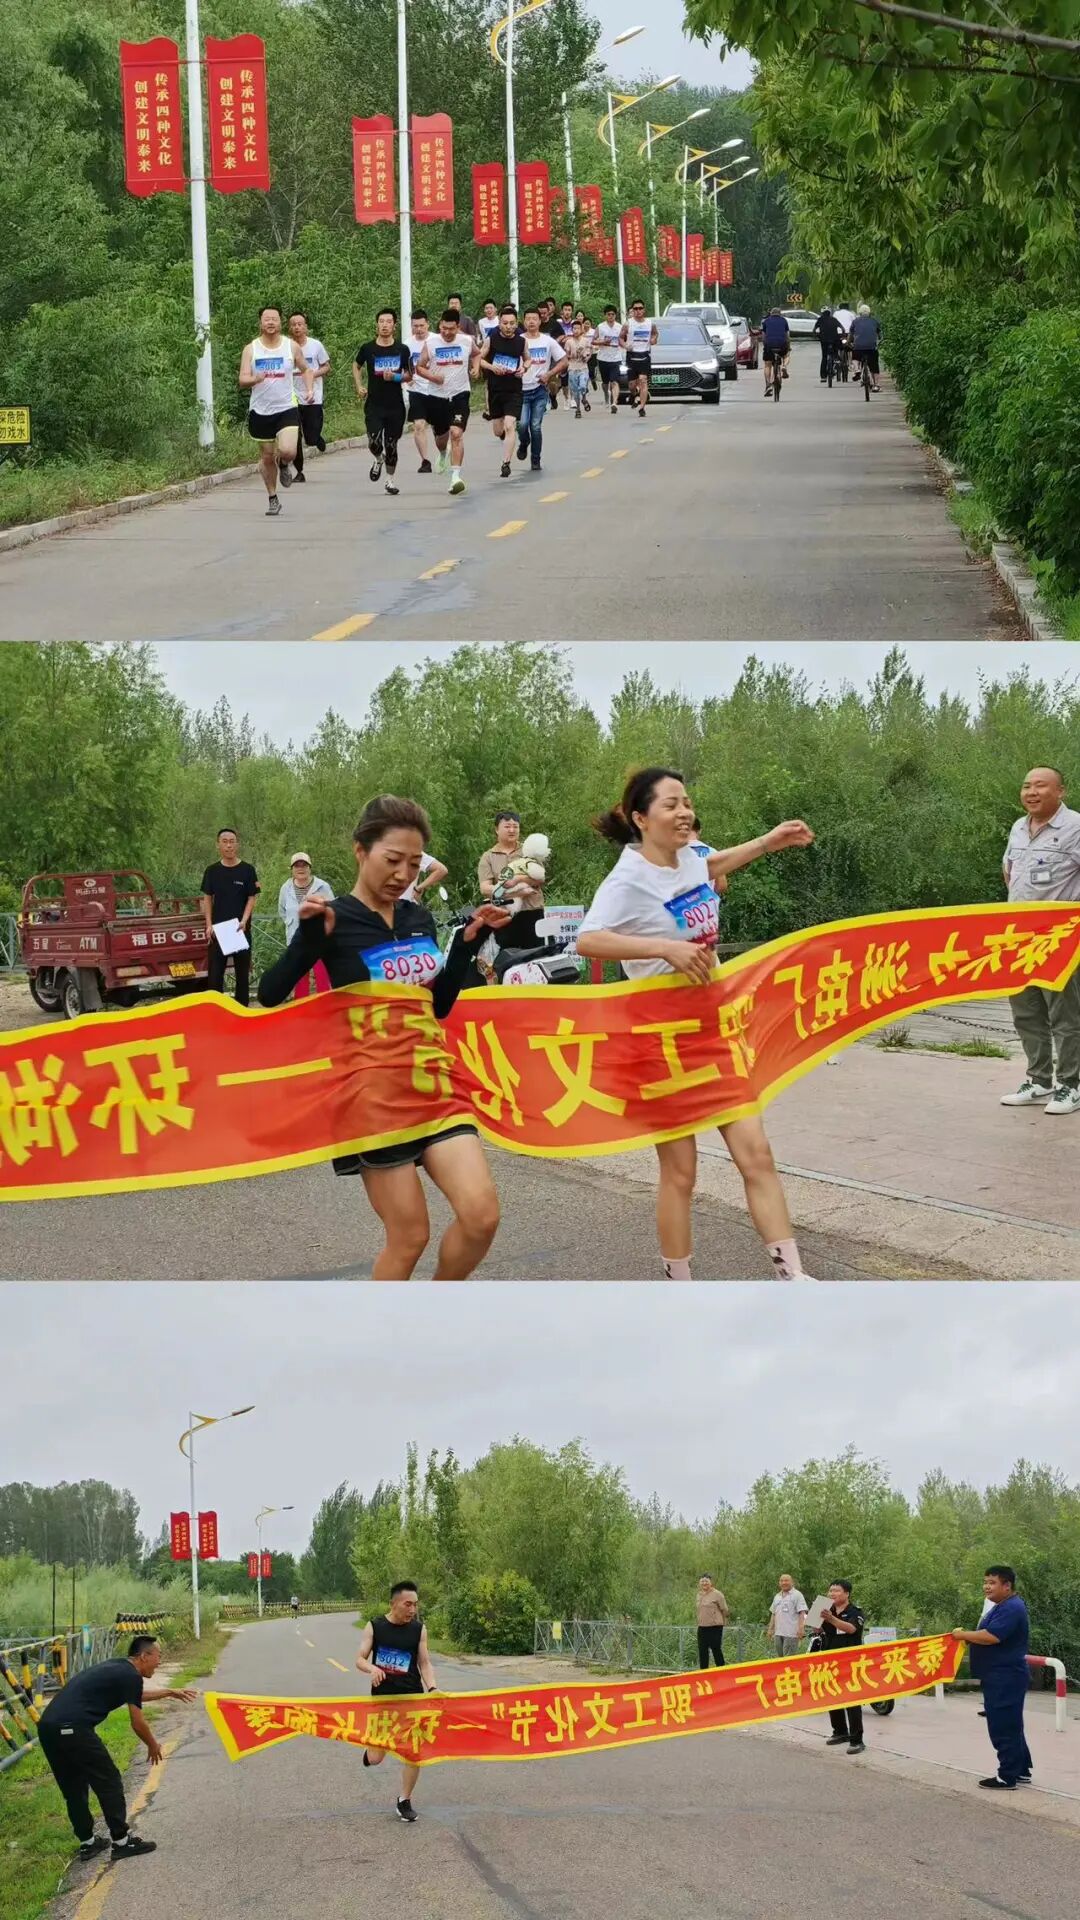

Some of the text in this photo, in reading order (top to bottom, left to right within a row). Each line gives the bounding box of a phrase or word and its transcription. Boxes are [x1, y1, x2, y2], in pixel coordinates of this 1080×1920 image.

[134, 80, 151, 173] 创建文明泰来
[154, 72, 172, 166] 传承四种文化
[219, 77, 237, 170] 创建文明泰来
[239, 69, 257, 162] 传承四种文化
[80, 936, 97, 950] ATM
[131, 932, 166, 946] 福田
[383, 953, 436, 980] 8030
